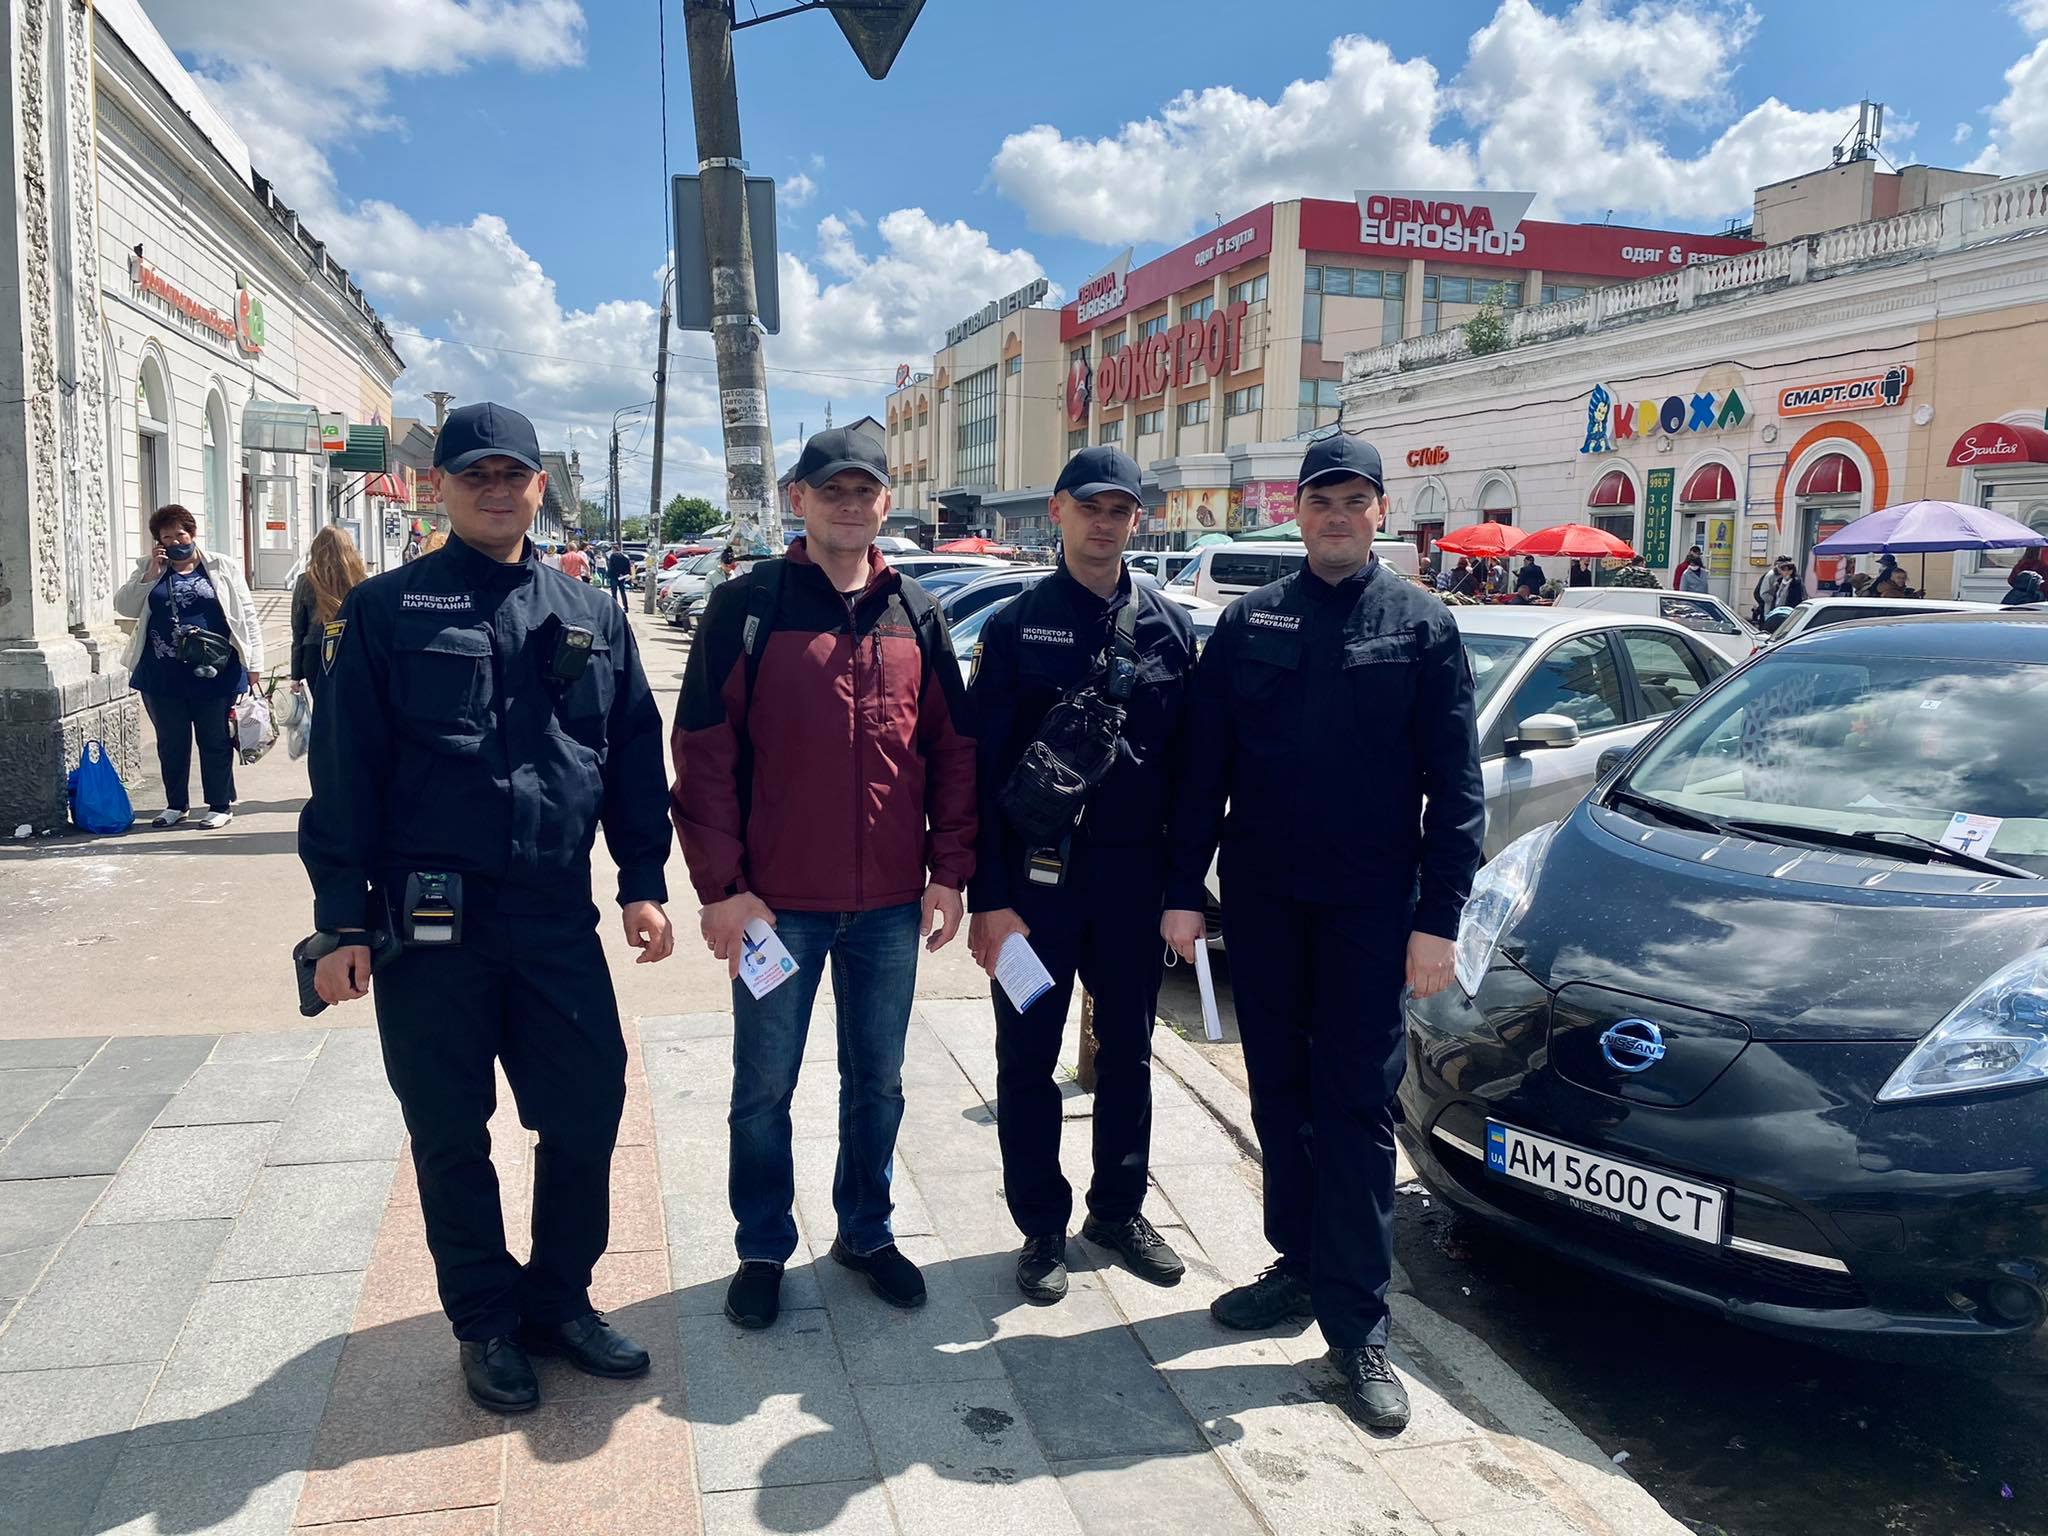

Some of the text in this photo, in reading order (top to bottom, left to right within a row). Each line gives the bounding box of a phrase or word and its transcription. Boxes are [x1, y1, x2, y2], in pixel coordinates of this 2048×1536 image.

[1367, 196, 1494, 230] OBNOVA
[1360, 217, 1525, 256] EUROSHOP
[1621, 246, 1664, 263] одяг
[1668, 246, 1682, 264] &
[1077, 285, 1128, 325] EUROSHOP
[1097, 301, 1247, 407] ФОКСТРОТ
[1783, 380, 1878, 407] СМАРТ.ОК
[1613, 388, 1747, 439] КРОХА
[1956, 437, 2018, 463] Sanitas
[402, 600, 471, 609] ПАРКУВАННЯ
[403, 593, 461, 603] ІНСПЕКТОР
[1249, 617, 1299, 629] ПАРКУВАННЯ
[1252, 612, 1294, 622] ІНСПЕКТОР
[1022, 633, 1074, 643] ПАРКУВАННЯ
[1023, 627, 1067, 637] ІНСПЕКТОР
[1603, 1035, 1656, 1055] NISSAN
[1490, 1152, 1504, 1165] UA
[1509, 1139, 1713, 1231] AM 5600 CT
[1569, 1197, 1621, 1222] NISSAN
